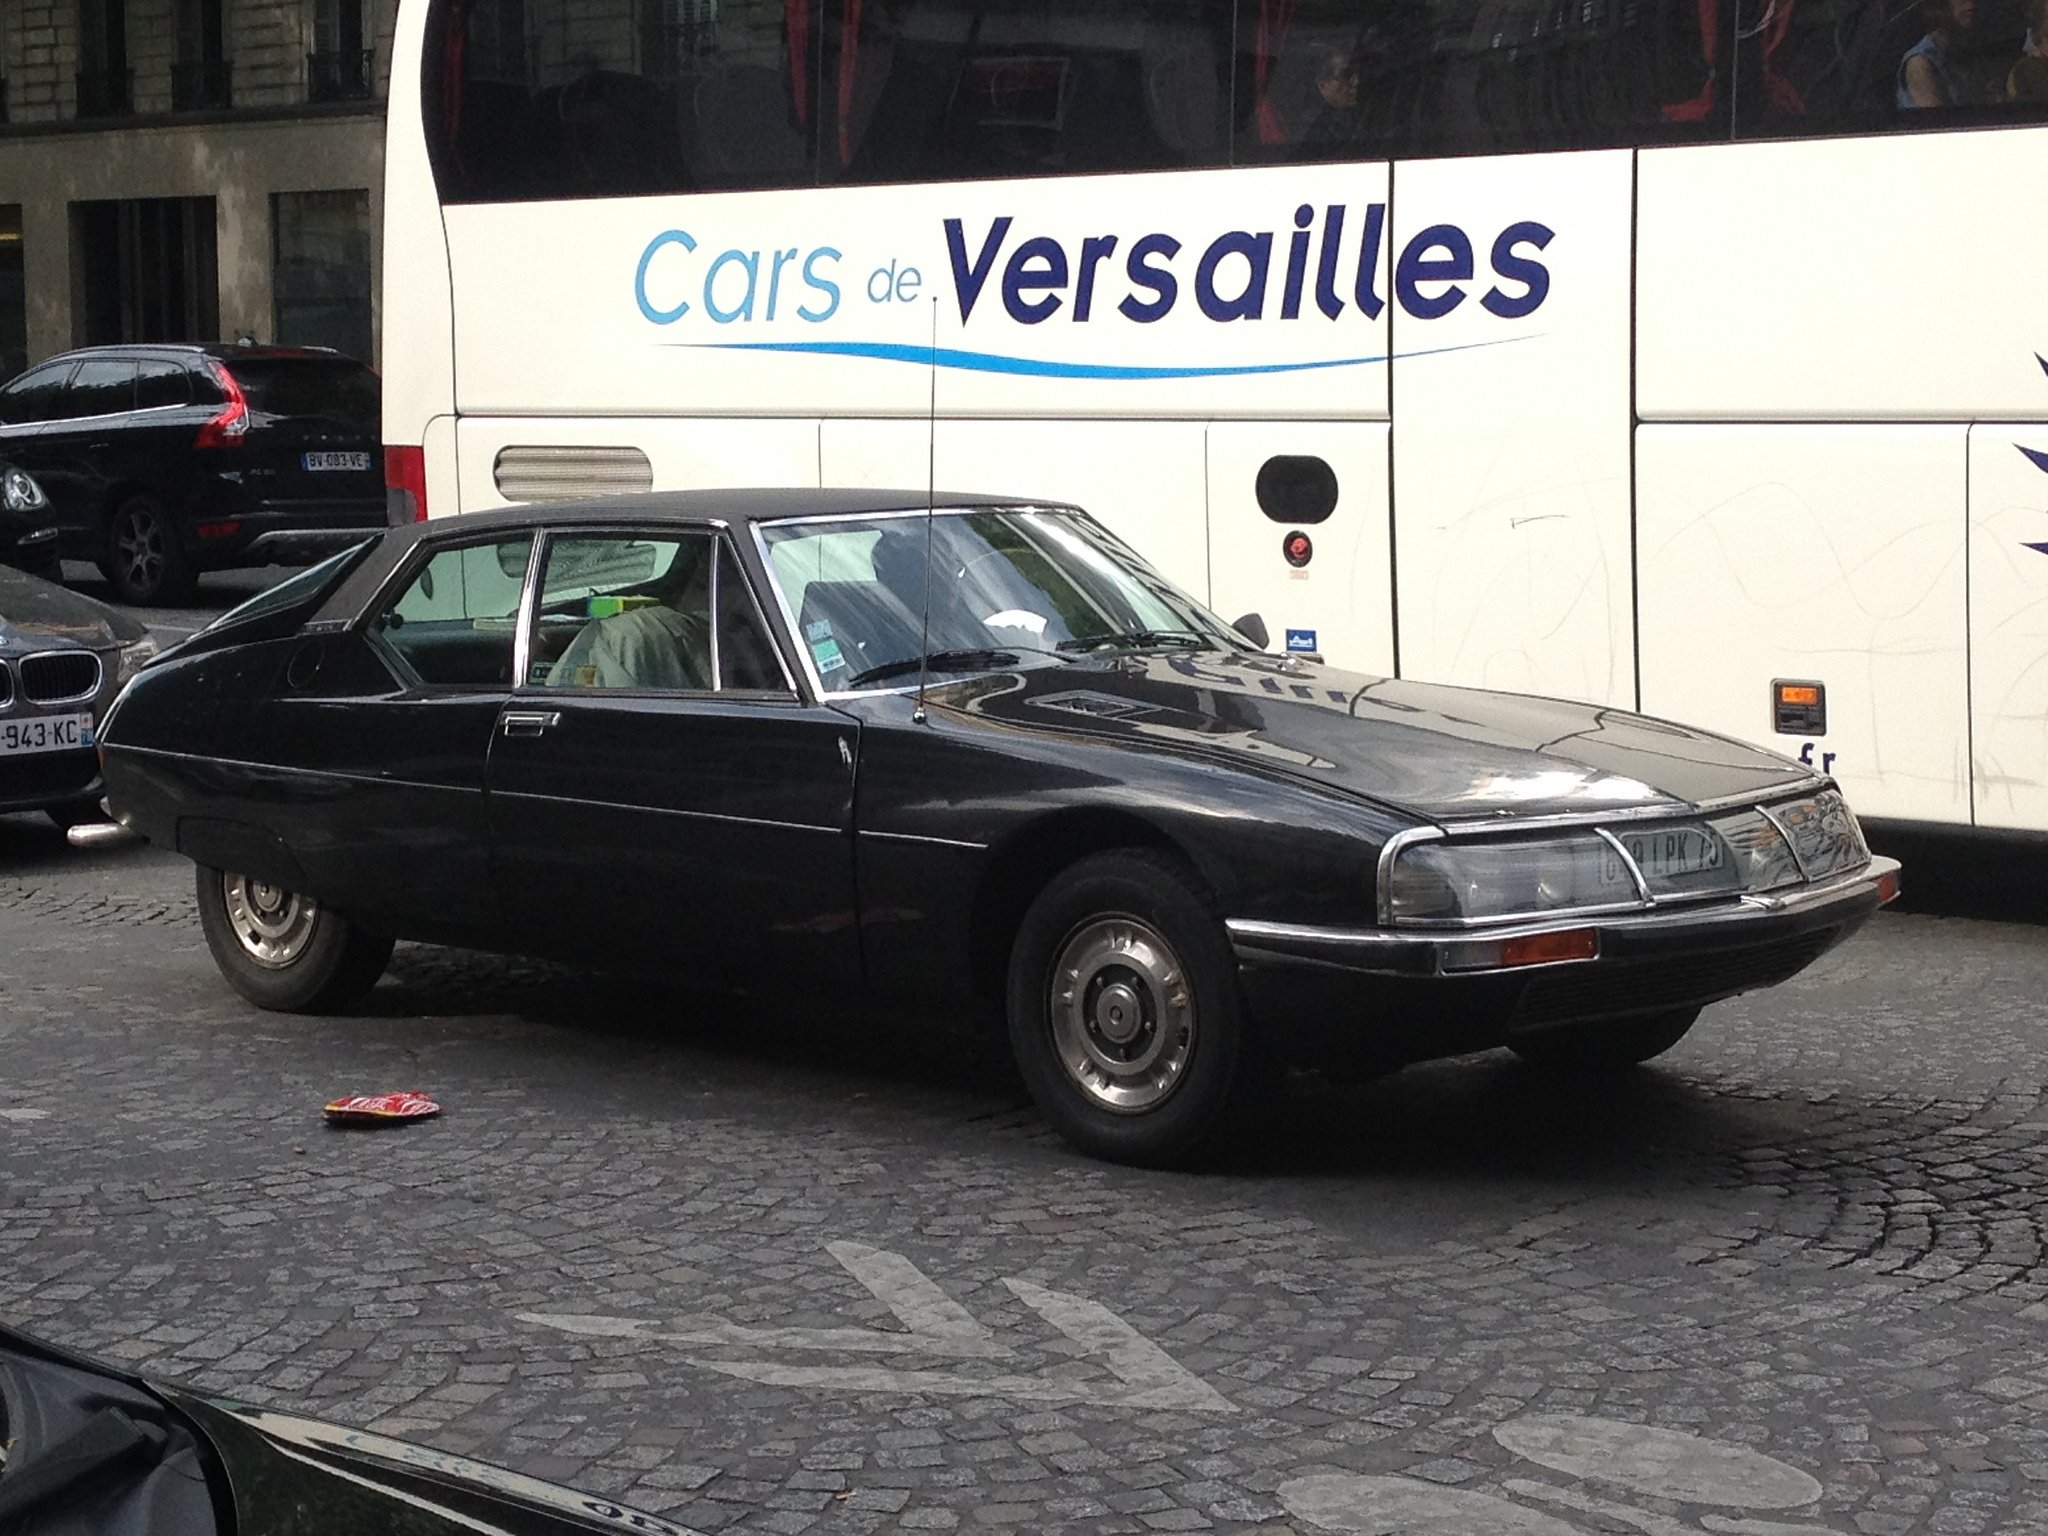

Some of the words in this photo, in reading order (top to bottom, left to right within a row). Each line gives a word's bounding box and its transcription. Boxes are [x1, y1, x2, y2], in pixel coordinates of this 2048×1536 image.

[635, 229, 842, 325] Cars
[867, 258, 922, 303] de
[943, 203, 1556, 328] Versailles
